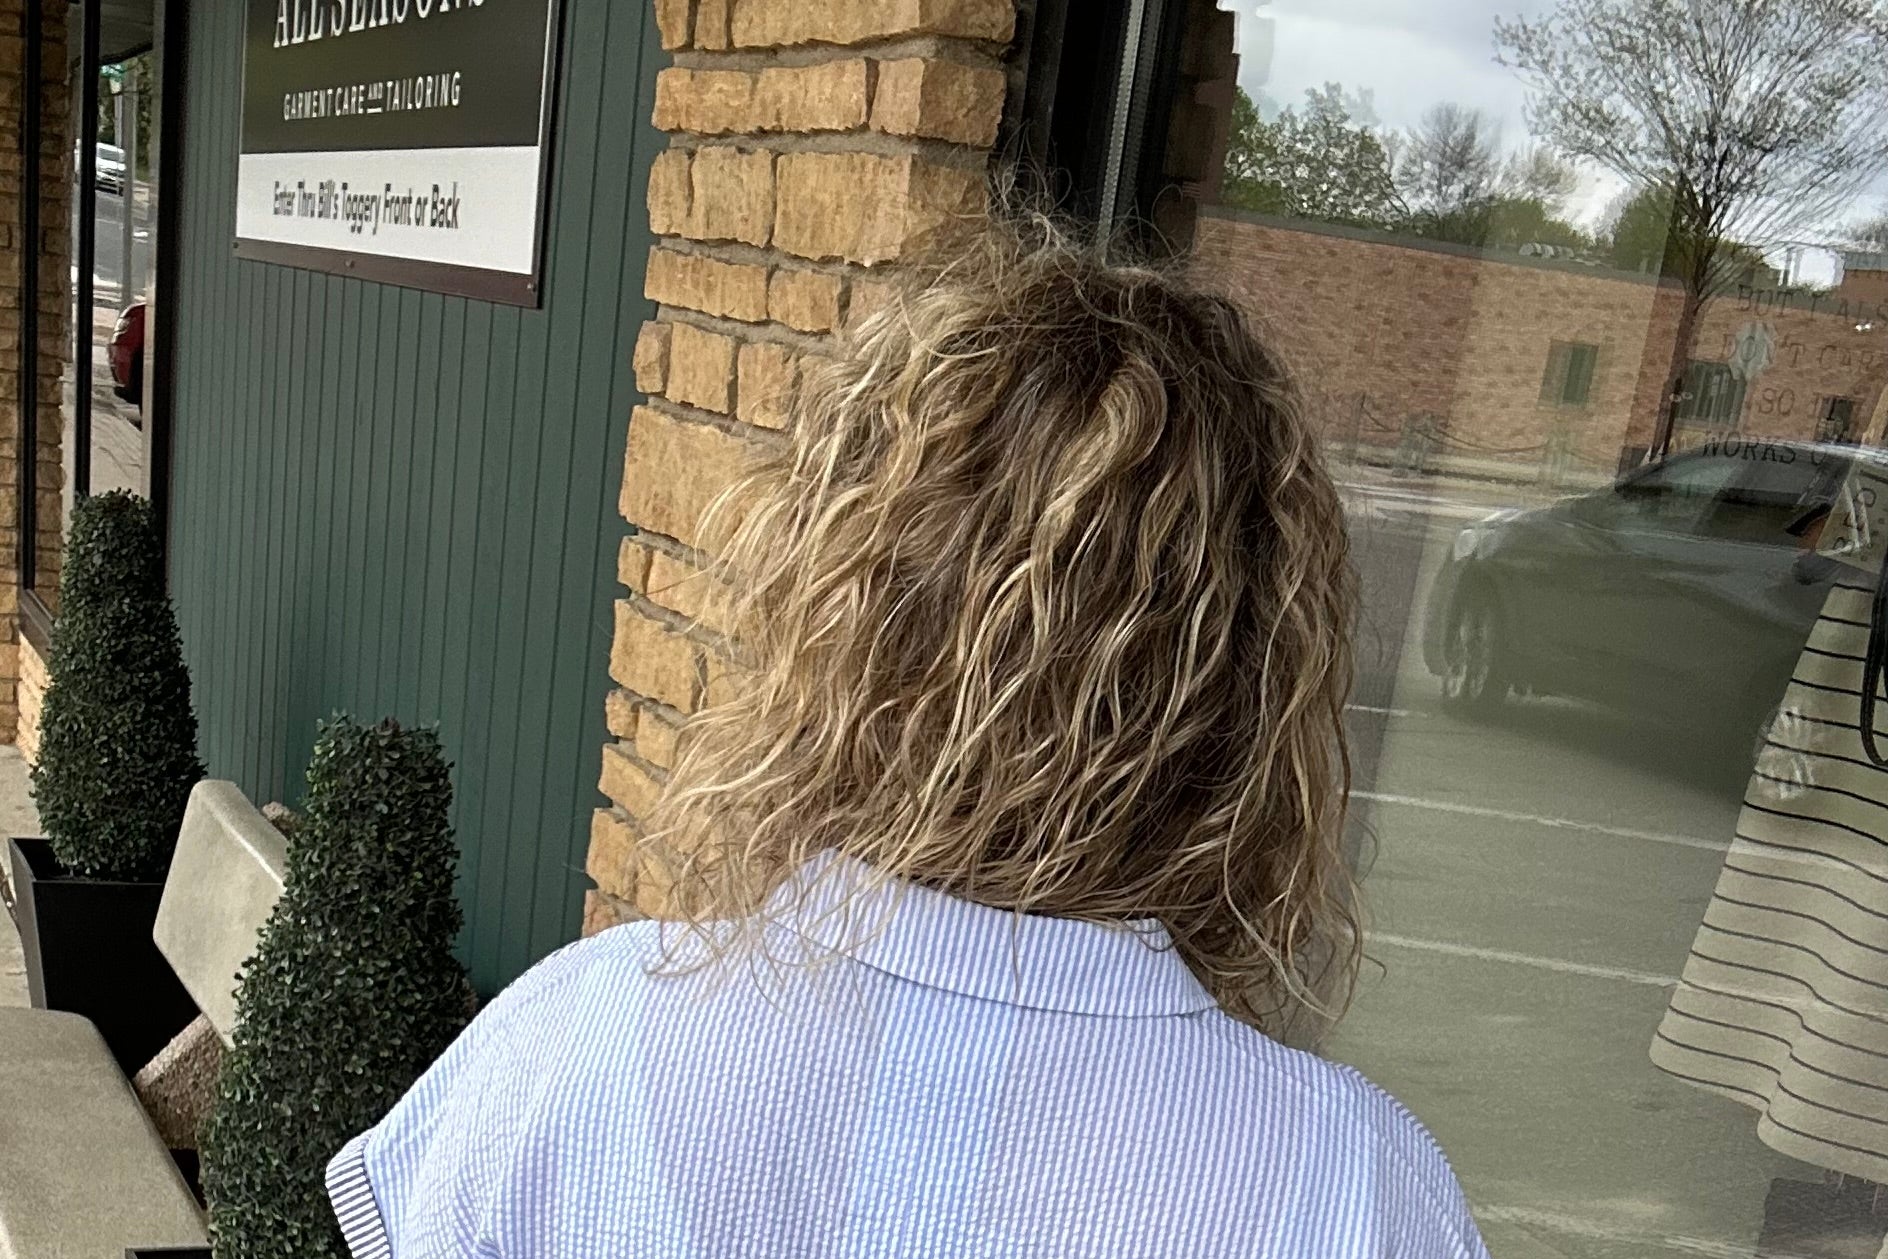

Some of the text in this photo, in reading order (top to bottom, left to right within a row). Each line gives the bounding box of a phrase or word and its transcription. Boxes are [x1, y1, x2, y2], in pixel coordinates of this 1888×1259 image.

[273, 0, 324, 48] ALL
[284, 71, 462, 120] GARMENT CARE AND TAILORING
[341, 182, 381, 235] Toggery
[383, 183, 412, 226] Front
[415, 195, 428, 227] or
[431, 181, 460, 229] Back
[1758, 387, 1796, 417] SO
[1702, 431, 1797, 465] WORKS
